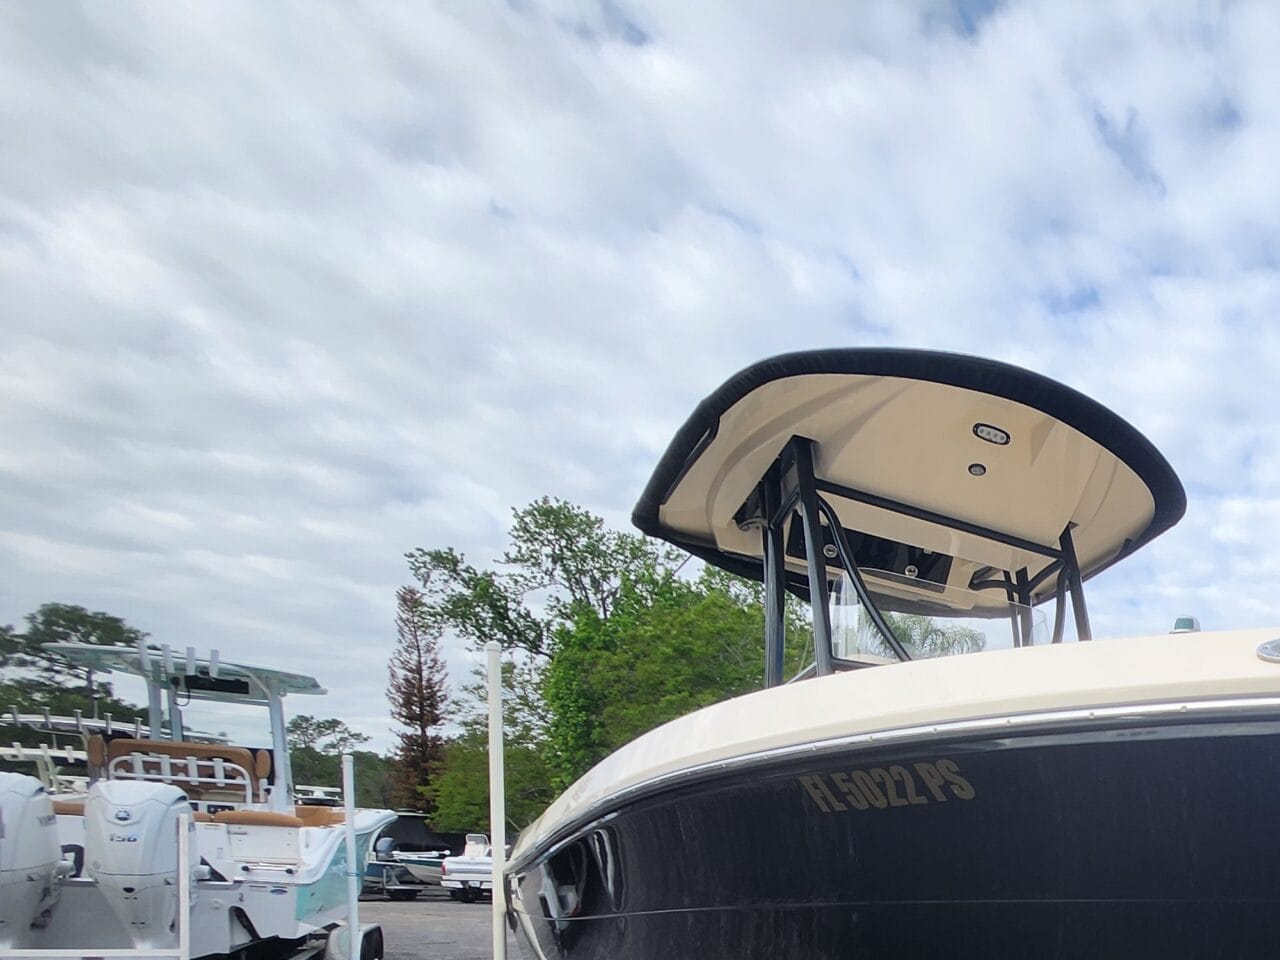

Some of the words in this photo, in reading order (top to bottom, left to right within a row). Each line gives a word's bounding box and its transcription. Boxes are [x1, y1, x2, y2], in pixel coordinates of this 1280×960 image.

[798, 774, 848, 813] FL
[830, 765, 929, 810] 5022
[913, 759, 976, 802] PS
